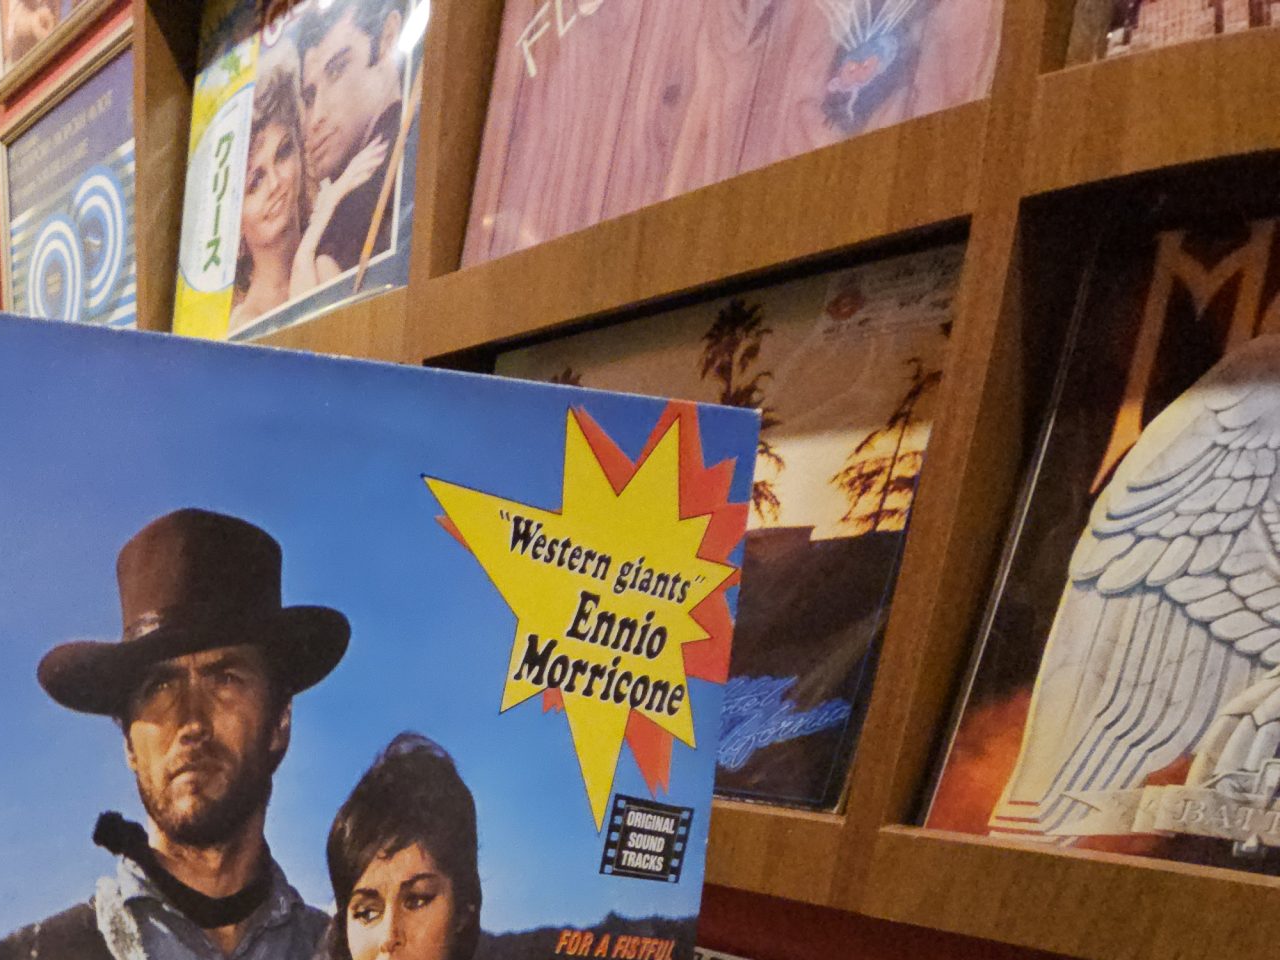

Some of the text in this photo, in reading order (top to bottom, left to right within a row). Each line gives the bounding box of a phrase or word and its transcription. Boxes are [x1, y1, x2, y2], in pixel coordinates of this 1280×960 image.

[566, 591, 668, 659] Ennio
[514, 634, 685, 715] Morricone
[626, 811, 675, 834] ORIGINAL
[628, 832, 665, 853] SOUND
[621, 850, 664, 872] TRACKS
[556, 930, 595, 956] FOR
[594, 934, 611, 957] A
